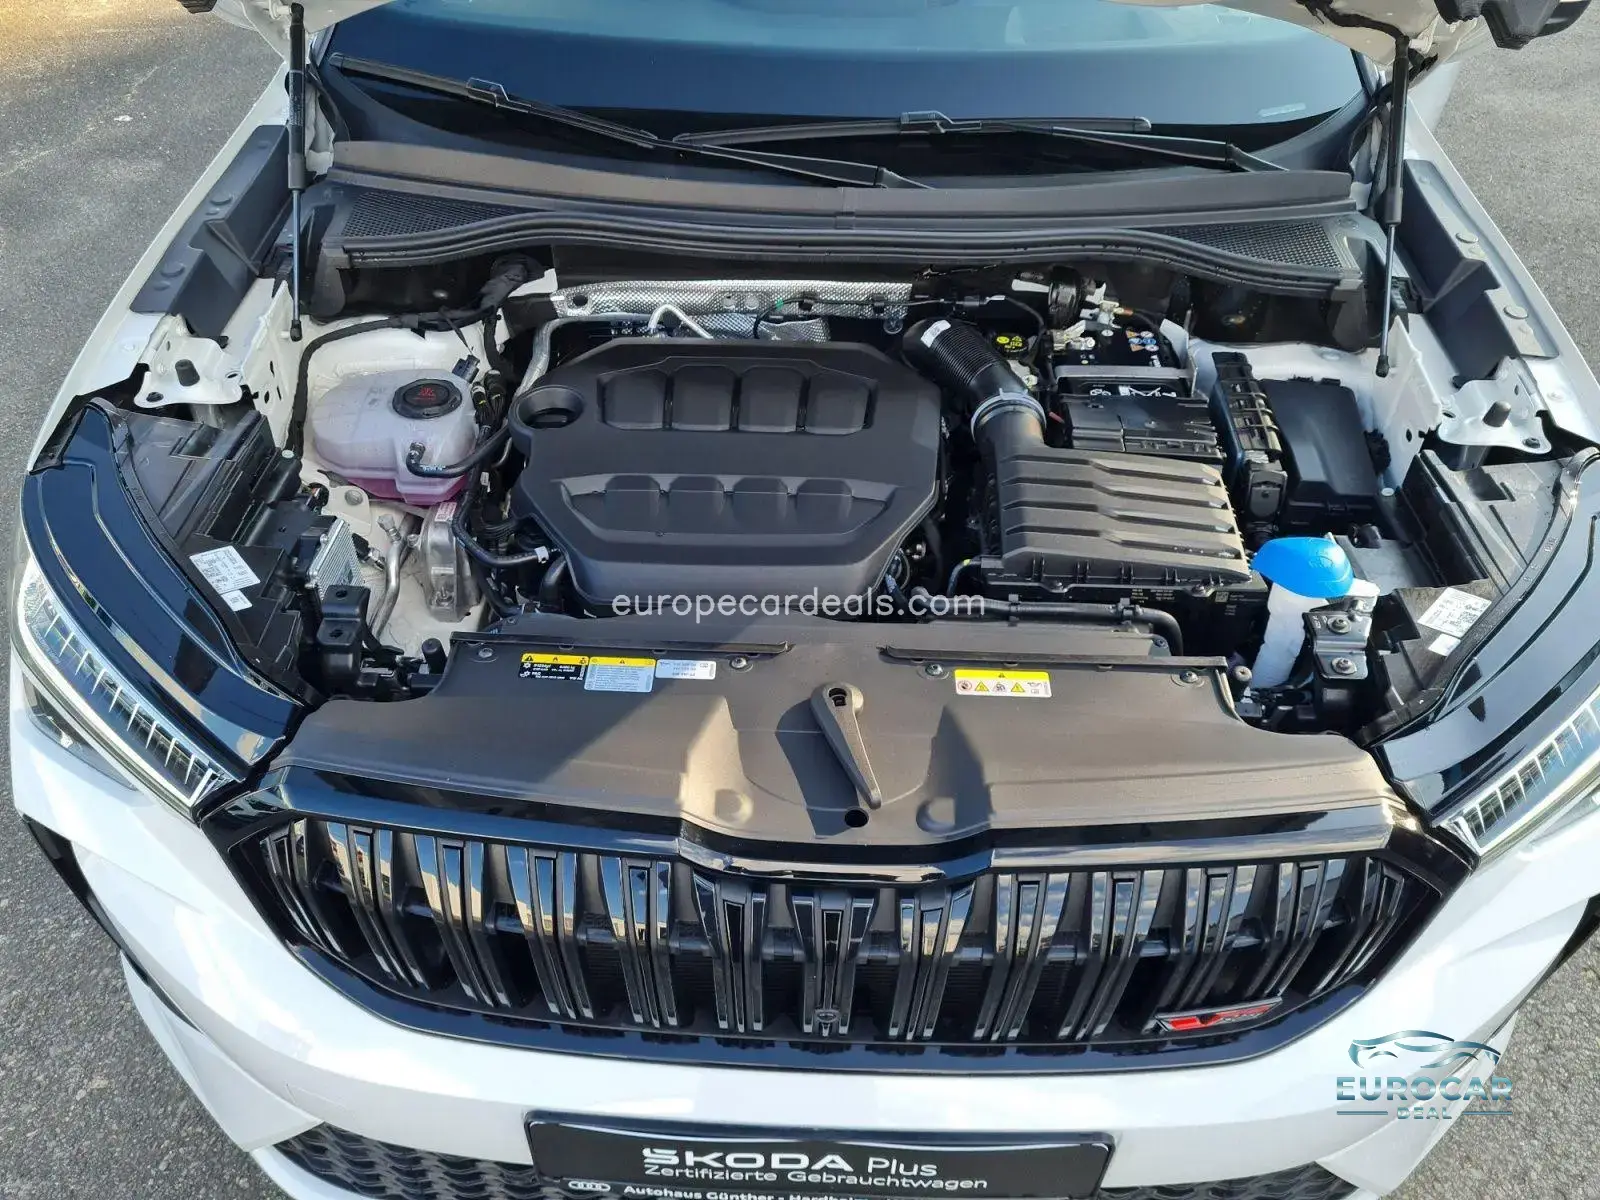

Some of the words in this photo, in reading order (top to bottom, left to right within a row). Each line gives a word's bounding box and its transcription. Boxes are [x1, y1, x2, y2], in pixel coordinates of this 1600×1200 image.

[866, 1156, 938, 1177] Plus
[644, 1164, 778, 1182] Zertifizierte
[787, 1170, 988, 1191] Gebrauchtwagen
[623, 1185, 703, 1200] Autohaus
